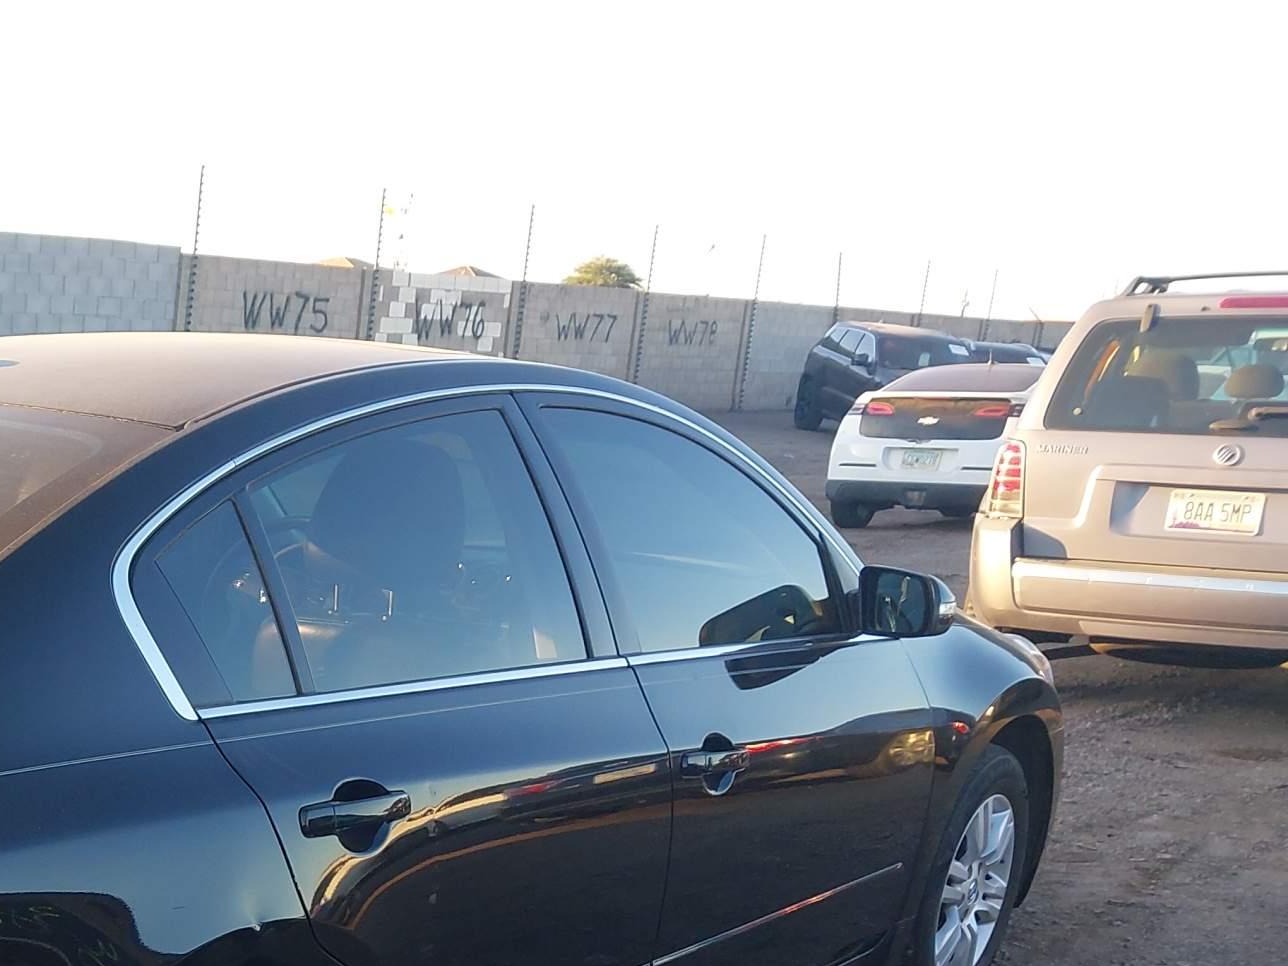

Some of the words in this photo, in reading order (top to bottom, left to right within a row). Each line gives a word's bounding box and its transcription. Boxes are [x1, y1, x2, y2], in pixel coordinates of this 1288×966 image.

[243, 290, 329, 334] WW75
[415, 299, 486, 341] WW76
[556, 313, 617, 343] WW77
[1183, 501, 1214, 521] 8AA
[1220, 503, 1253, 524] 5MP
